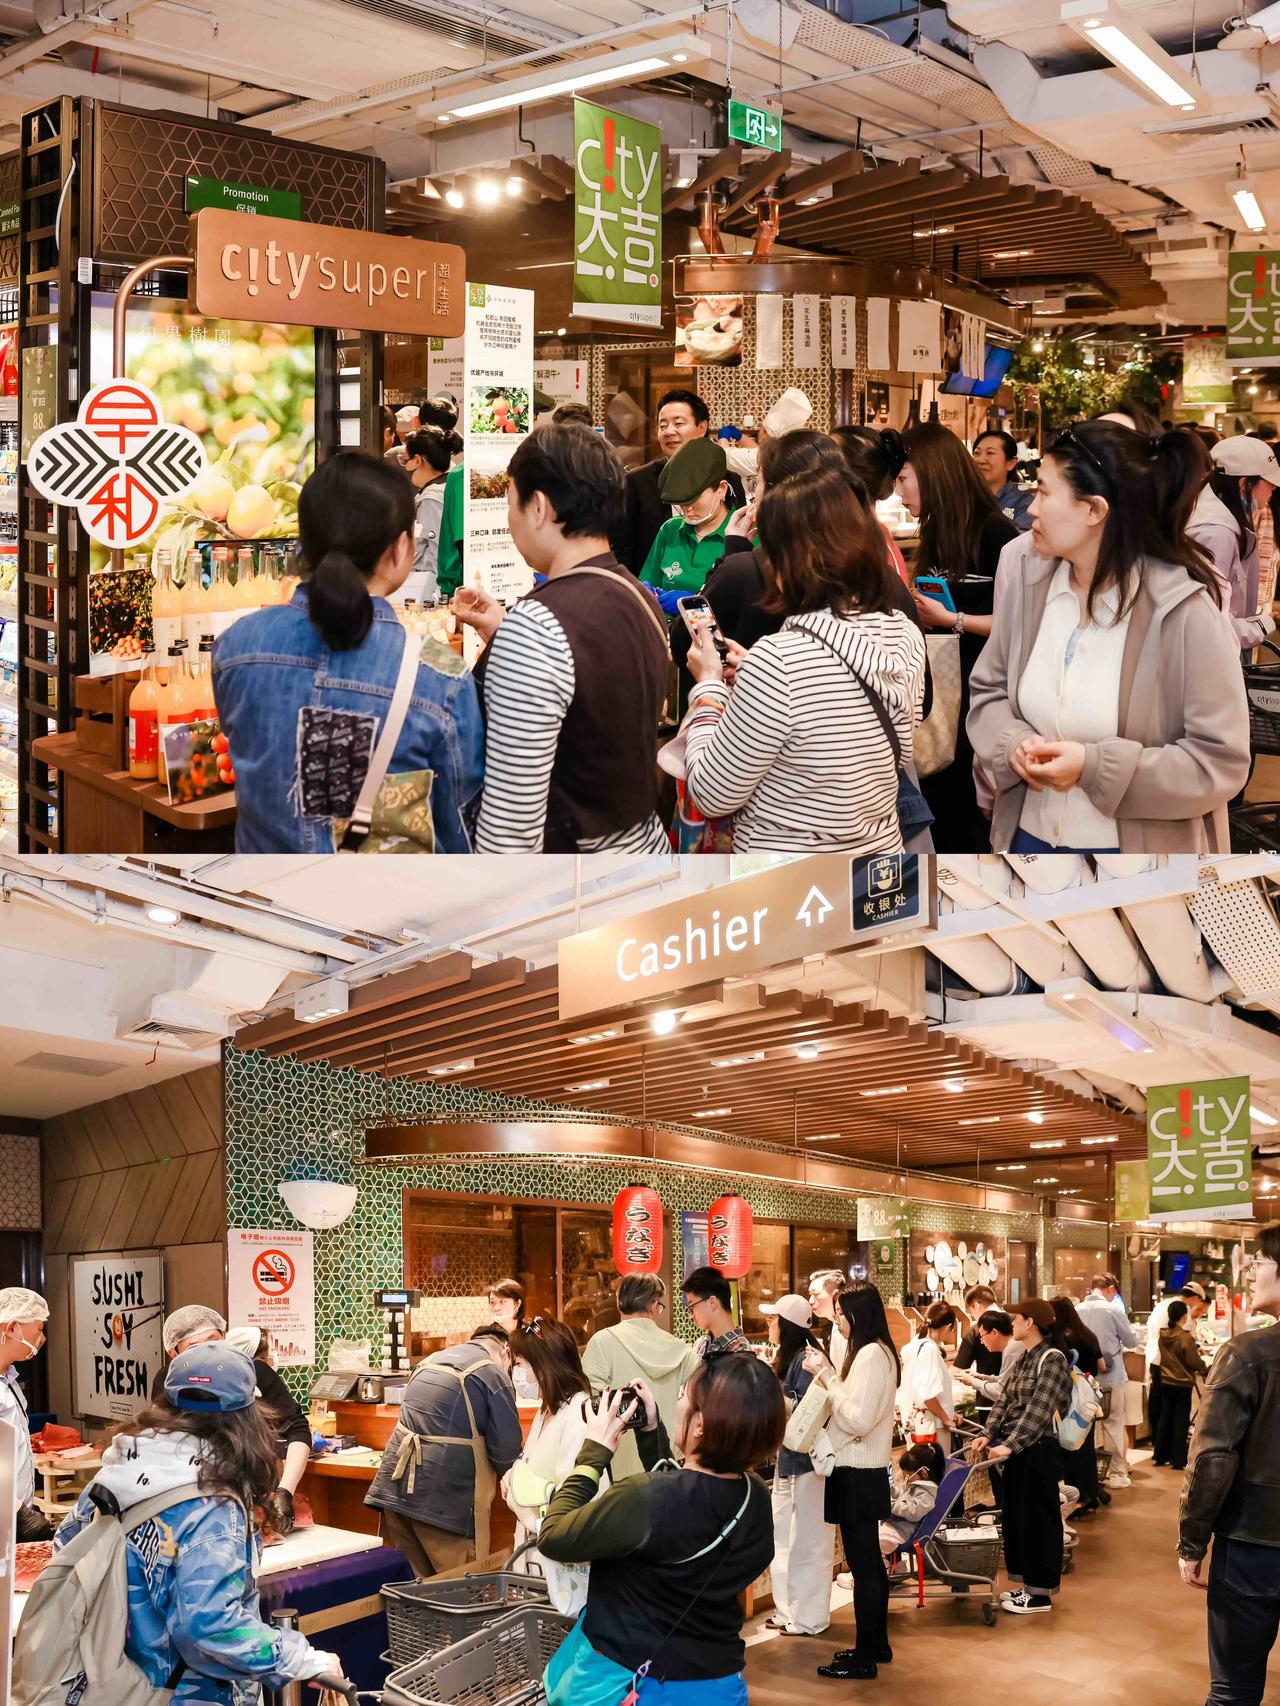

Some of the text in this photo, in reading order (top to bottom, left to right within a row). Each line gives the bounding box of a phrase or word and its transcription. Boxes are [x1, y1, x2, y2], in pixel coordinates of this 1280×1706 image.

[223, 186, 269, 203] Promotion
[235, 203, 257, 215] 促销
[577, 191, 660, 269] 大吉
[1229, 299, 1280, 334] 大
[863, 894, 907, 916] 收银处
[872, 909, 899, 922] CASHIER
[616, 907, 769, 982] Cashier
[1151, 1135, 1249, 1184] 大吉
[625, 1206, 653, 1264] うなぎ
[710, 1215, 731, 1266] うなぎ
[92, 1266, 145, 1306] SUSHI
[259, 1297, 290, 1306] 禁止吸烟
[101, 1312, 134, 1351] SOY
[94, 1355, 148, 1401] FRESH
